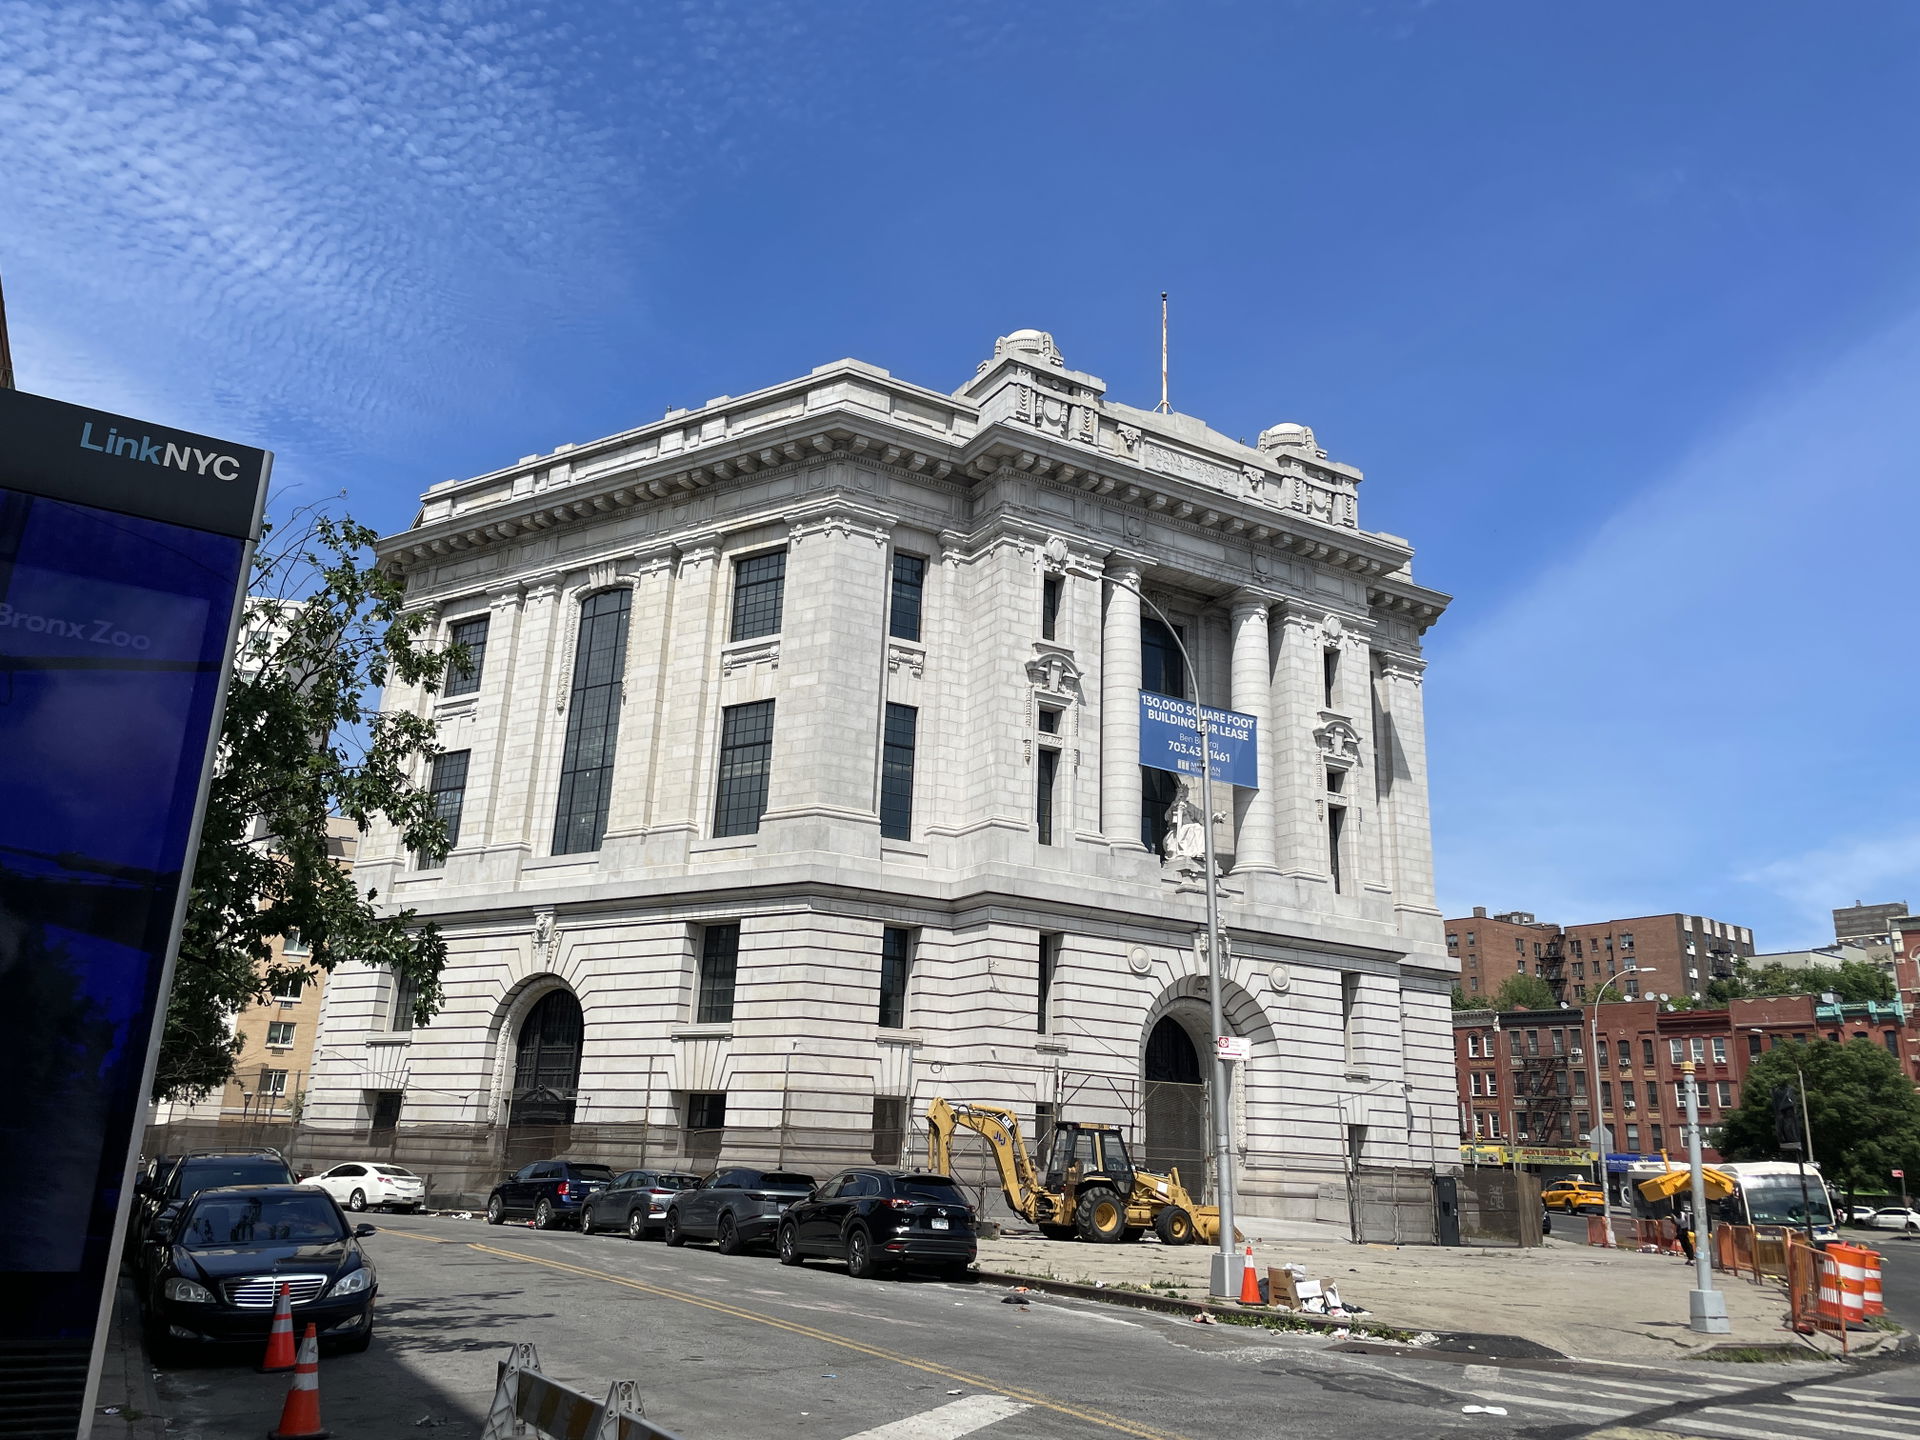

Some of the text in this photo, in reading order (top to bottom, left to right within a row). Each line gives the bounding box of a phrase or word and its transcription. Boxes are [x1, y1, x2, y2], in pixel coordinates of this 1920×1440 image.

[80, 422, 240, 481] LinkNYC
[1149, 446, 1183, 464] BRONX
[0, 603, 150, 650] Bronx Zoo
[1141, 694, 1184, 713] 130,000
[1227, 714, 1255, 730] FOOT
[1148, 709, 1249, 741] BUILDING OR LEASE
[1168, 740, 1231, 763] 703.431461
[1180, 733, 1193, 743] Ben
[1001, 1115, 1014, 1129] CAT
